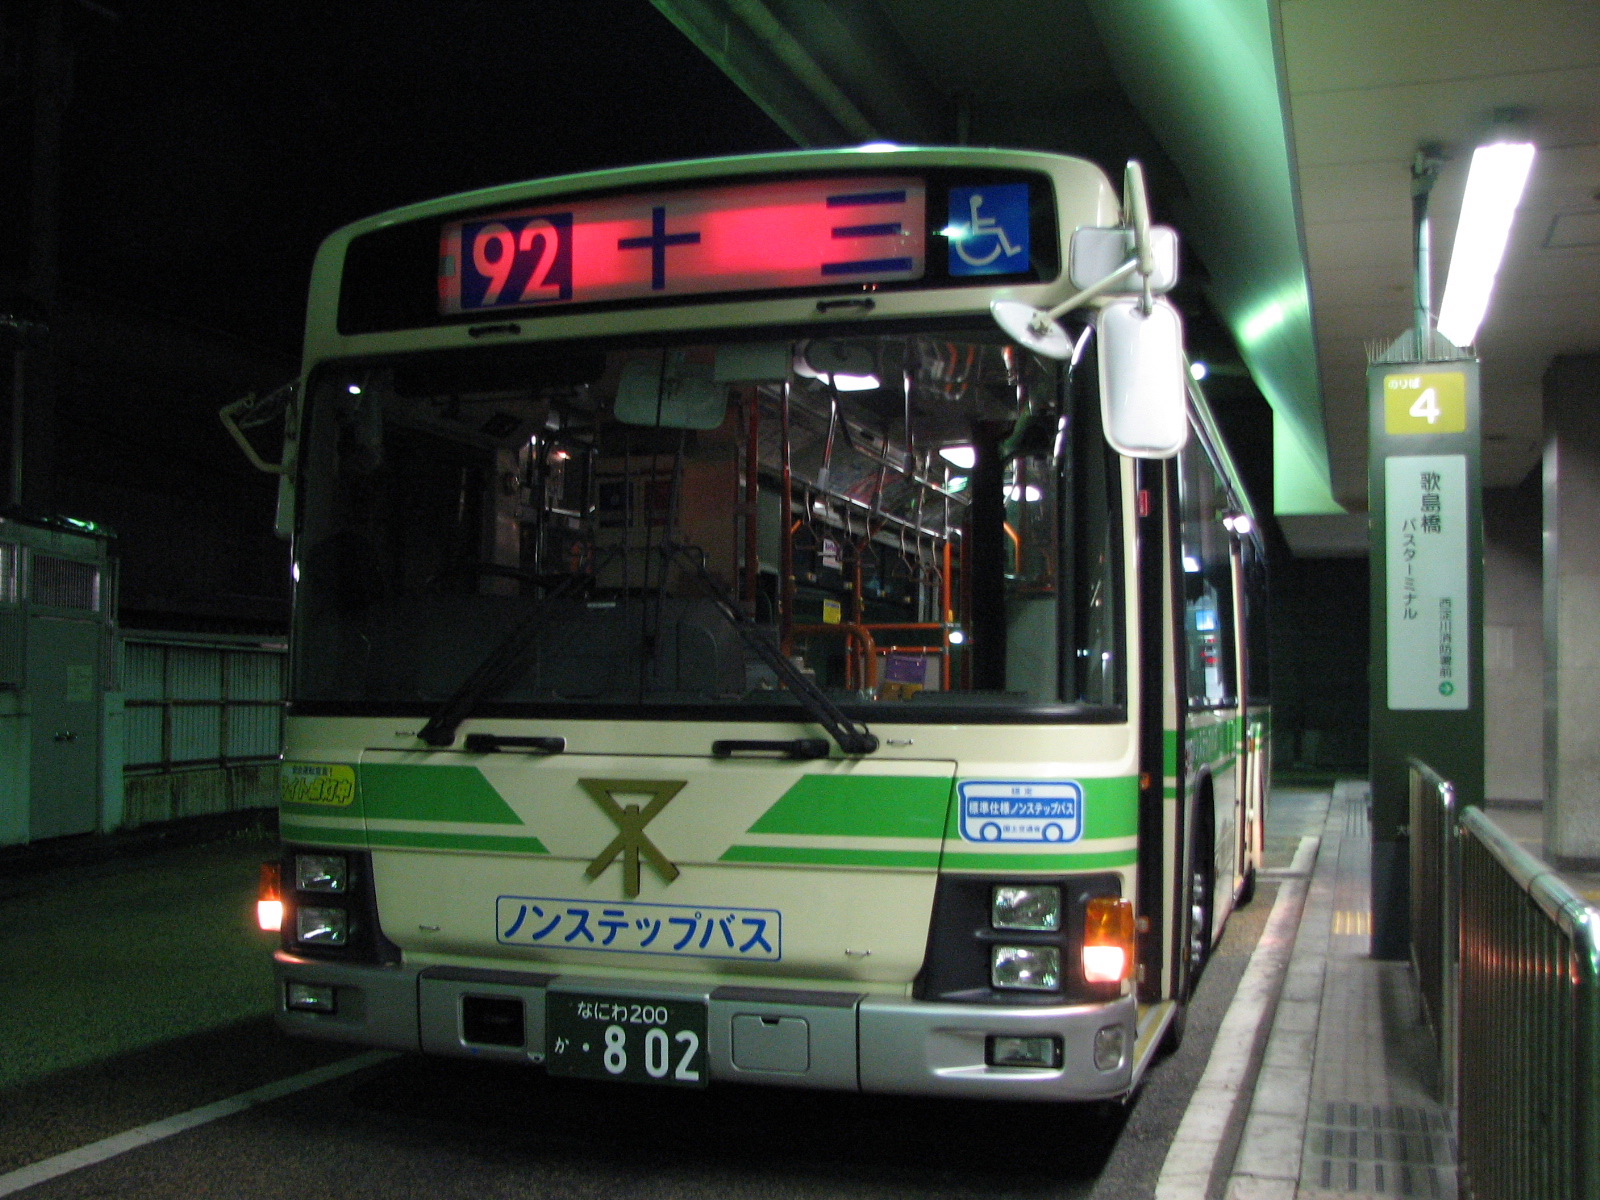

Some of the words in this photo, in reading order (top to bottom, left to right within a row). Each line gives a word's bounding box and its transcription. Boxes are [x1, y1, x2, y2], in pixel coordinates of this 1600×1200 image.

[473, 219, 560, 304] 92
[618, 190, 912, 290] 十三
[1409, 388, 1442, 424] 4
[1420, 471, 1441, 534] 歌島橋
[1402, 518, 1418, 620] バスターミナル
[968, 801, 1074, 815] 標準仕様ノンステップバス
[504, 904, 772, 953] ノンステップバス
[554, 1036, 569, 1054] か
